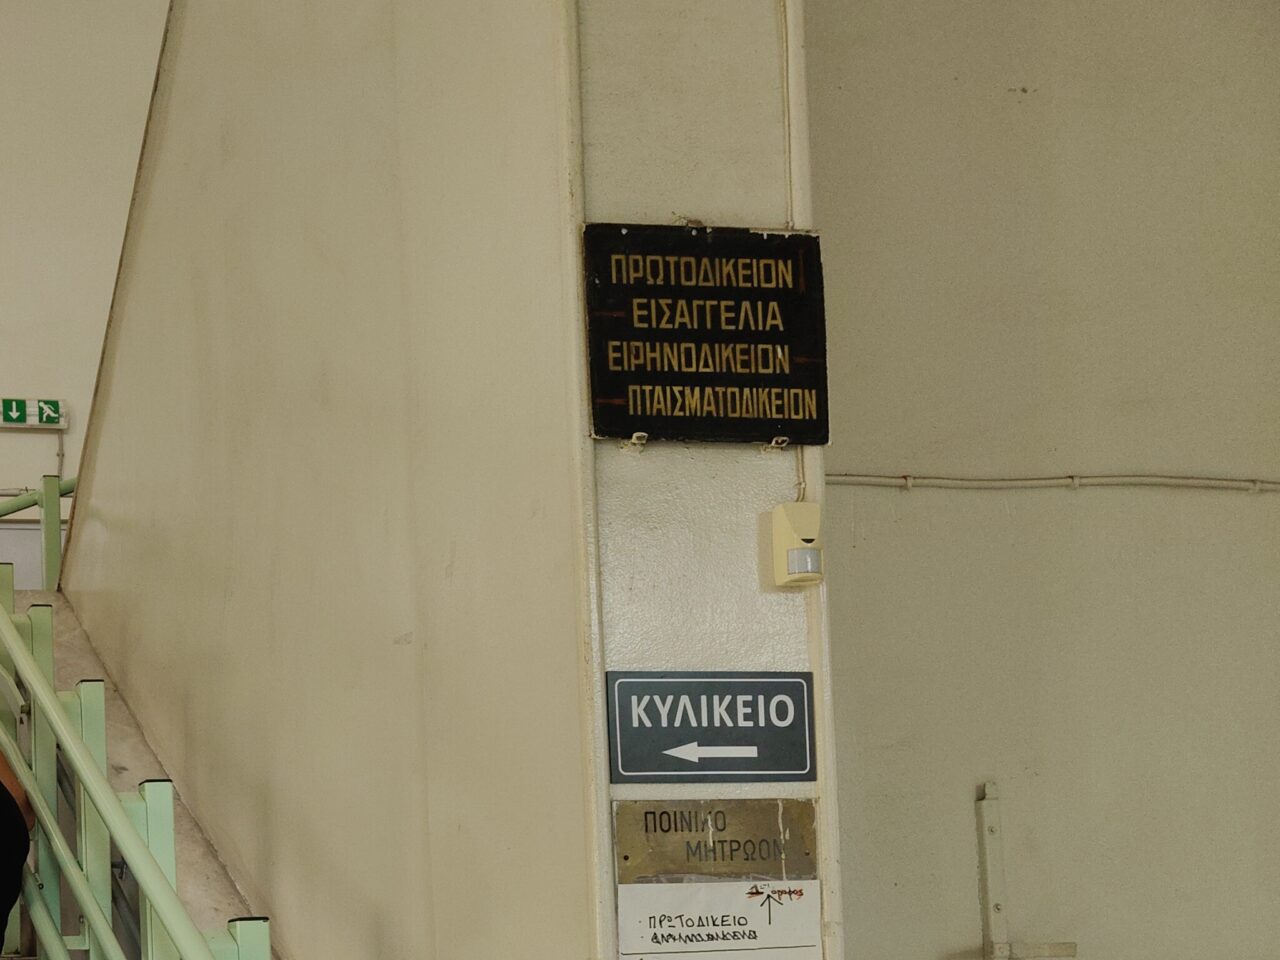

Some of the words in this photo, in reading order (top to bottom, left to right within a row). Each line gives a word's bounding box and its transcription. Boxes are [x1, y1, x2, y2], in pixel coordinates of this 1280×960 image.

[611, 254, 793, 289] ΠΡΩΤΟΔΙΚΕΙΟΝ
[632, 298, 784, 331] ΕΙΣΑΓΓΕΛΙΑ
[608, 340, 790, 374] ΕΙΡΗΝΟΔΙΚΕΙΟΝ
[628, 385, 817, 420] ΠΤΑΙΣΜΑΤΟΔΙΚΕΙΟΝ
[631, 694, 795, 728] ΚΥΛΙΚΕΙΟ
